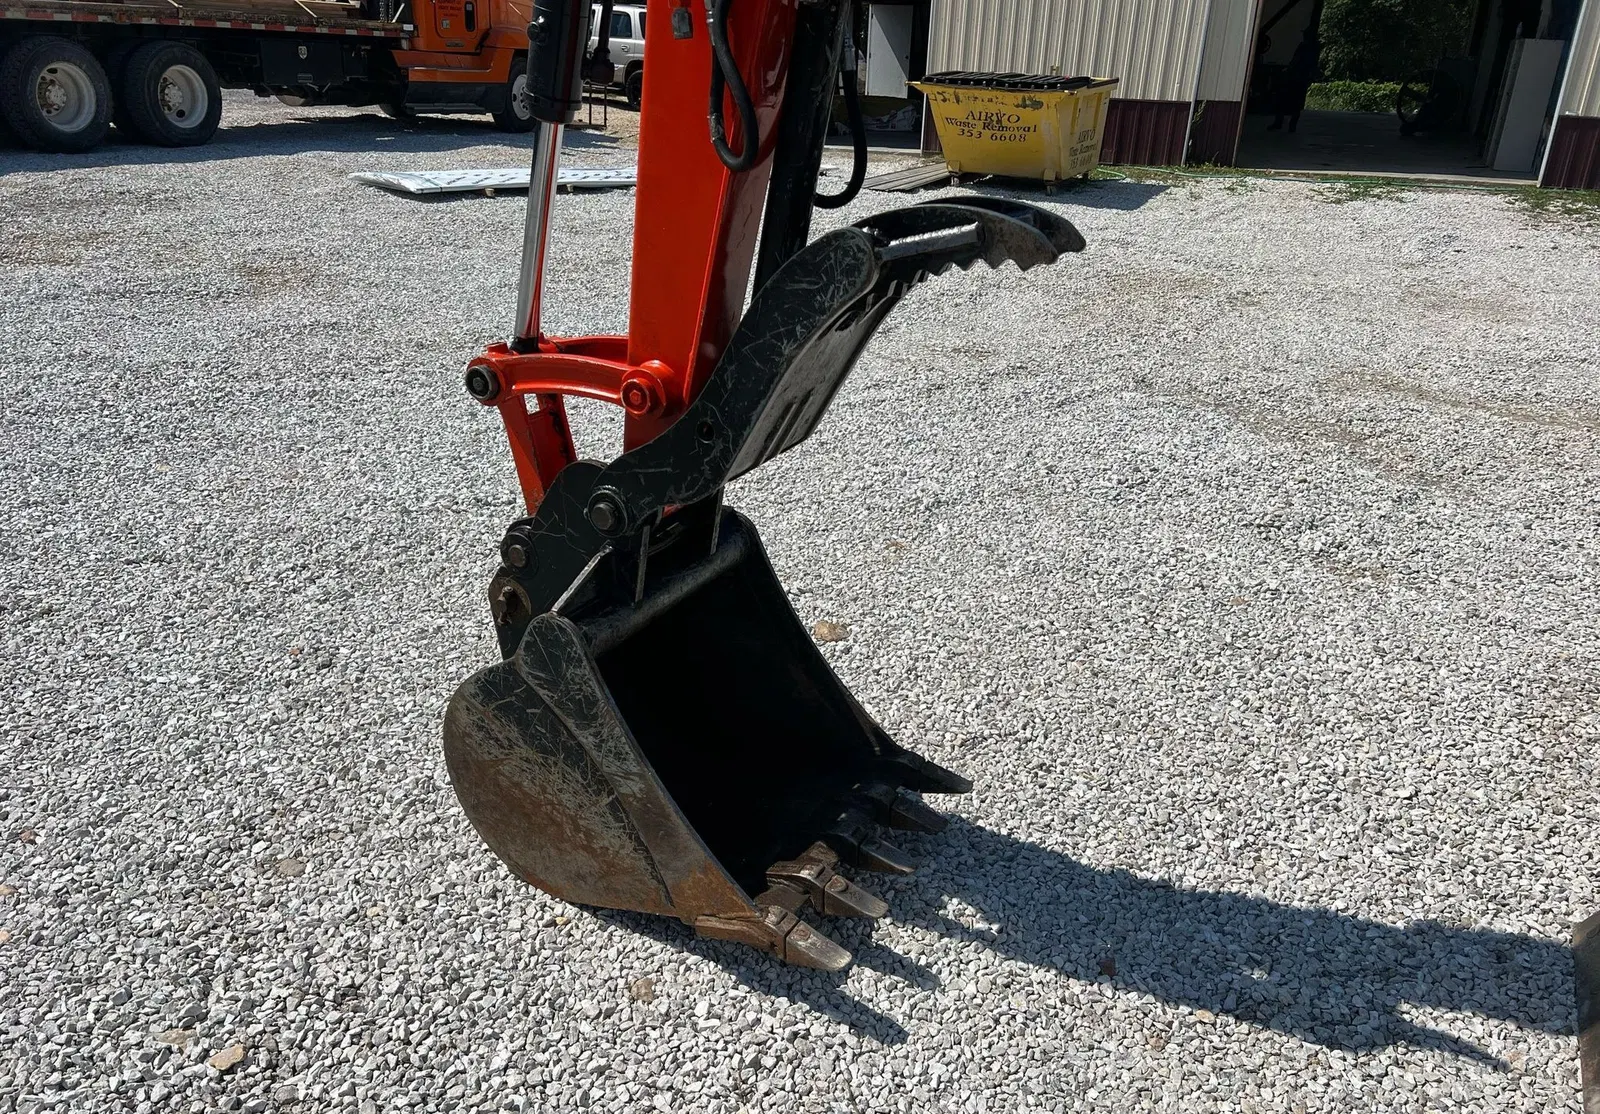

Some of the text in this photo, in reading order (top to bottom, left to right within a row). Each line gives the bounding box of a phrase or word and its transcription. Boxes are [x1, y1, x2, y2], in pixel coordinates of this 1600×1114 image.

[945, 117, 1037, 133] Waste Removal
[957, 128, 1027, 143] 353 6608
